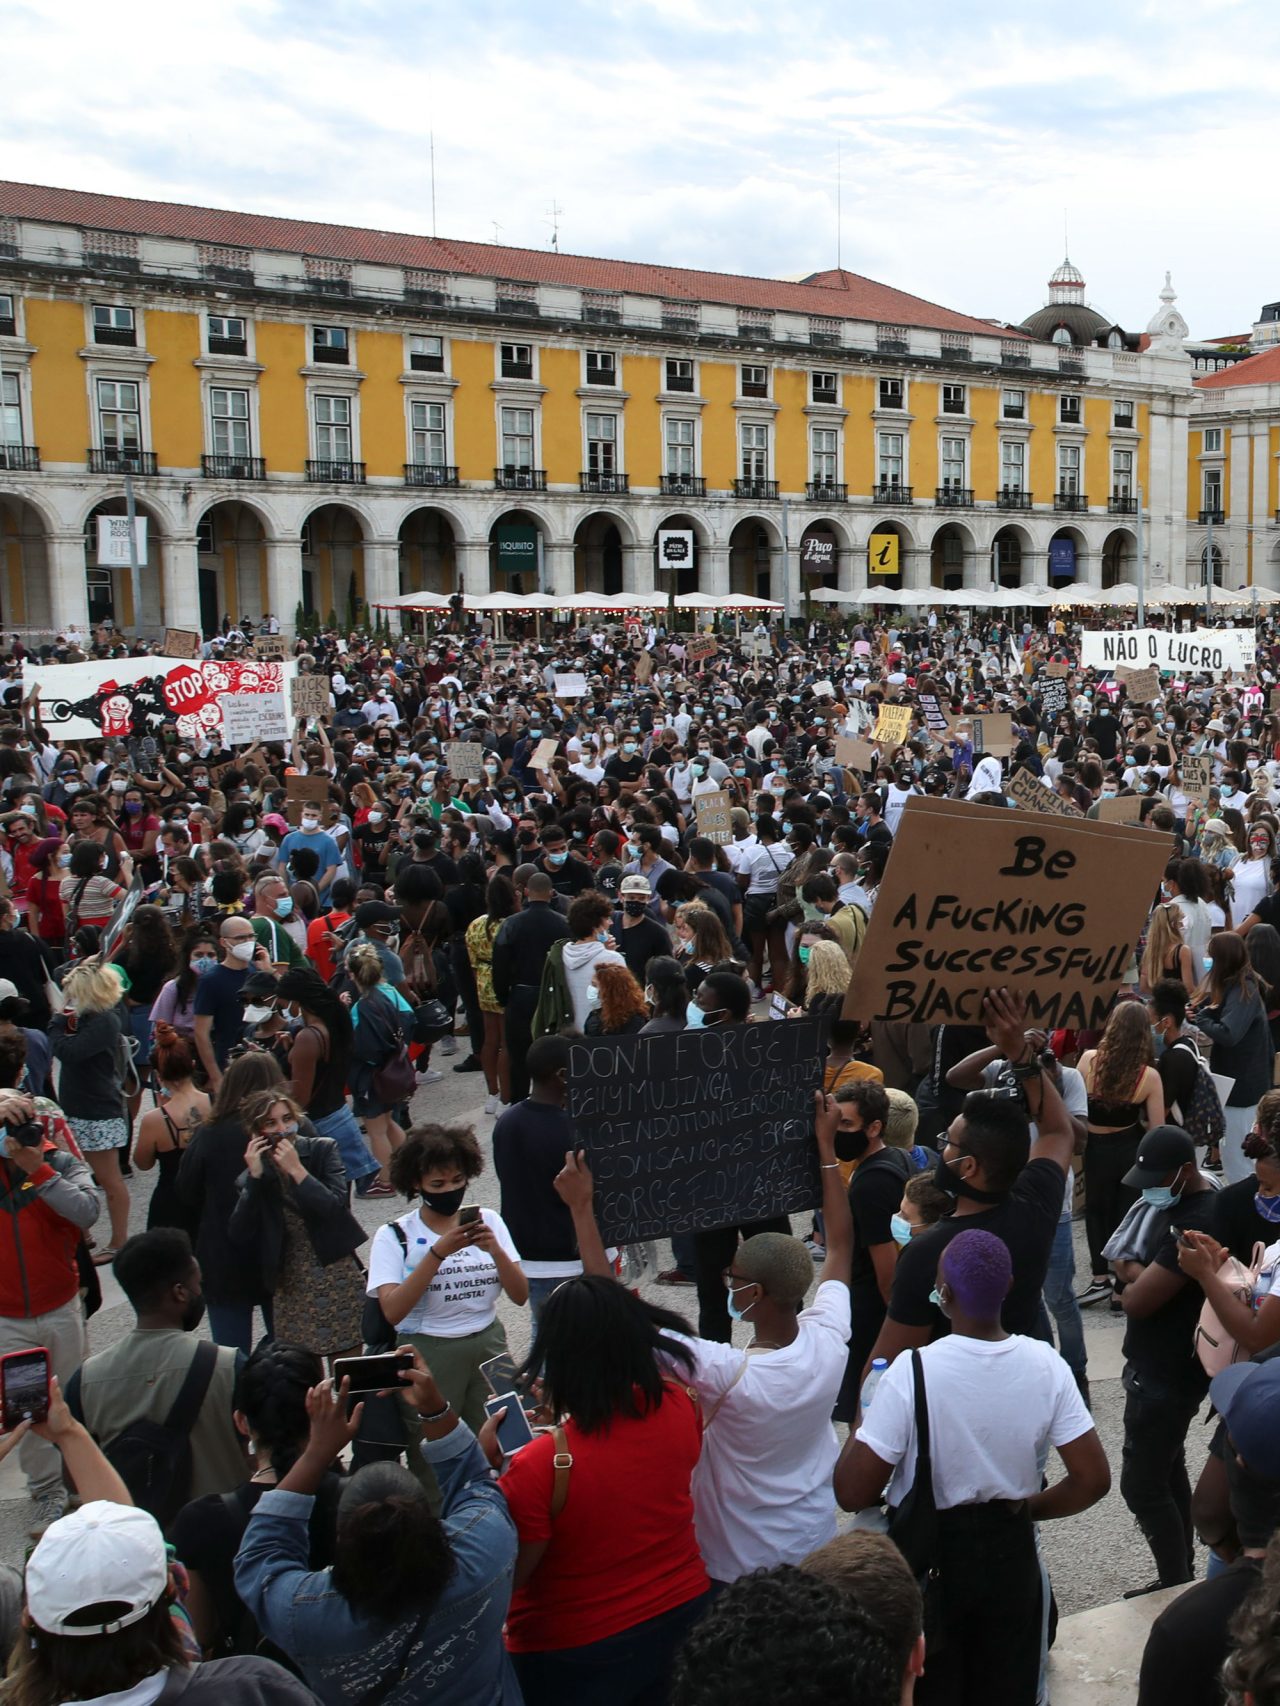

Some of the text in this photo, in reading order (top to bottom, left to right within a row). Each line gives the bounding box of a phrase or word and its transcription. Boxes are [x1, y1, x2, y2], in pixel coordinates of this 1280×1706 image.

[804, 538, 833, 554] Paço
[1103, 632, 1138, 661] NÃO
[1148, 634, 1158, 659] O
[1168, 639, 1223, 670] LUCRO
[165, 672, 203, 706] STOP
[292, 677, 326, 692] BLACK
[292, 691, 323, 702] LIVES
[1183, 756, 1201, 768] BLACK
[1183, 769, 1198, 780] LIVES
[1183, 781, 1201, 792] MATTER
[999, 836, 1077, 880] Be
[893, 893, 917, 929] A
[569, 1021, 822, 1078] DON'T FORGET!
[627, 1072, 734, 1113] MUJINGA
[454, 1276, 500, 1290] VIOLÊNCIA
[444, 1290, 486, 1303] RACISTA!
